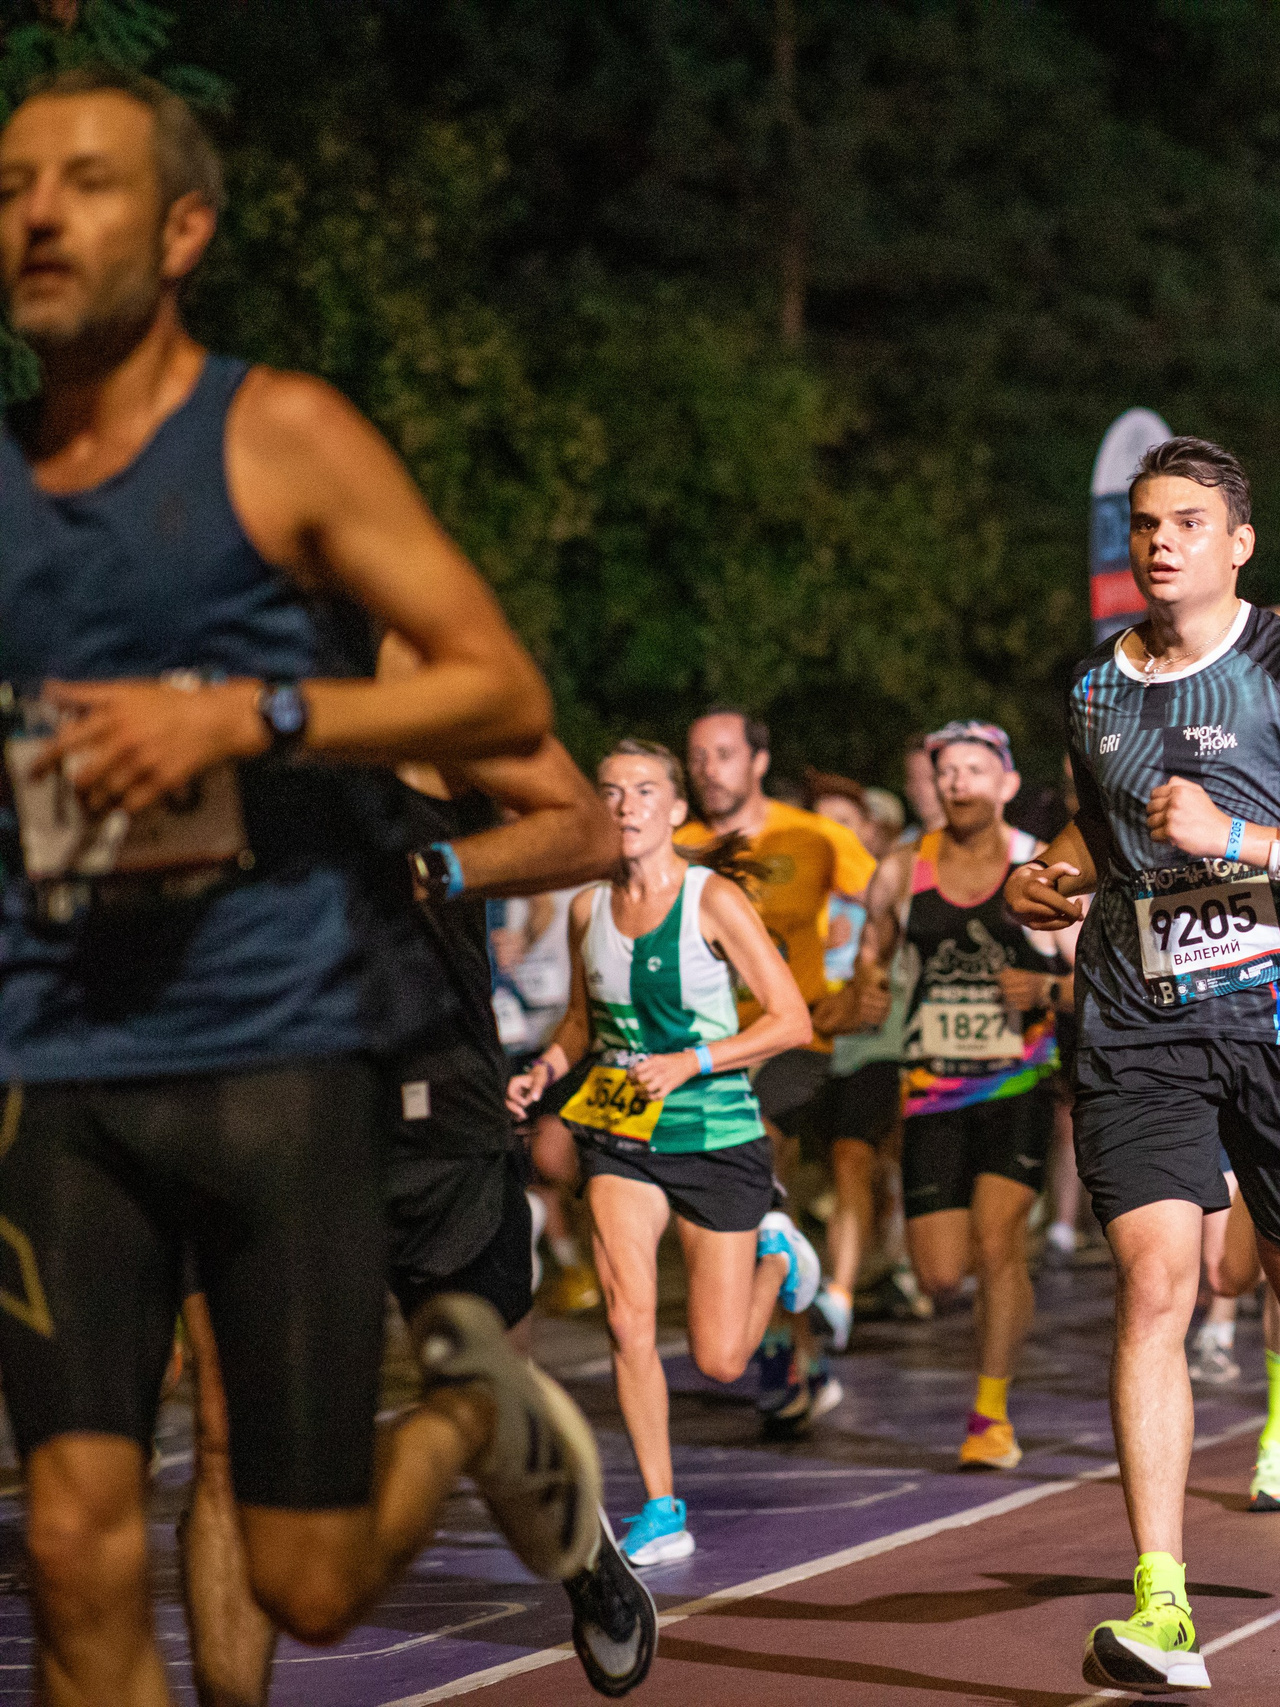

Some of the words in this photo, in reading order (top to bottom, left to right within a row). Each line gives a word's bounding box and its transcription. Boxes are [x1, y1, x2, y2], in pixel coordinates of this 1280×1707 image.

[1230, 821, 1242, 844] 9205
[1151, 892, 1257, 950] 9205
[1174, 939, 1240, 965] ВАЛЕРИЙ
[938, 1012, 1008, 1040] 1827
